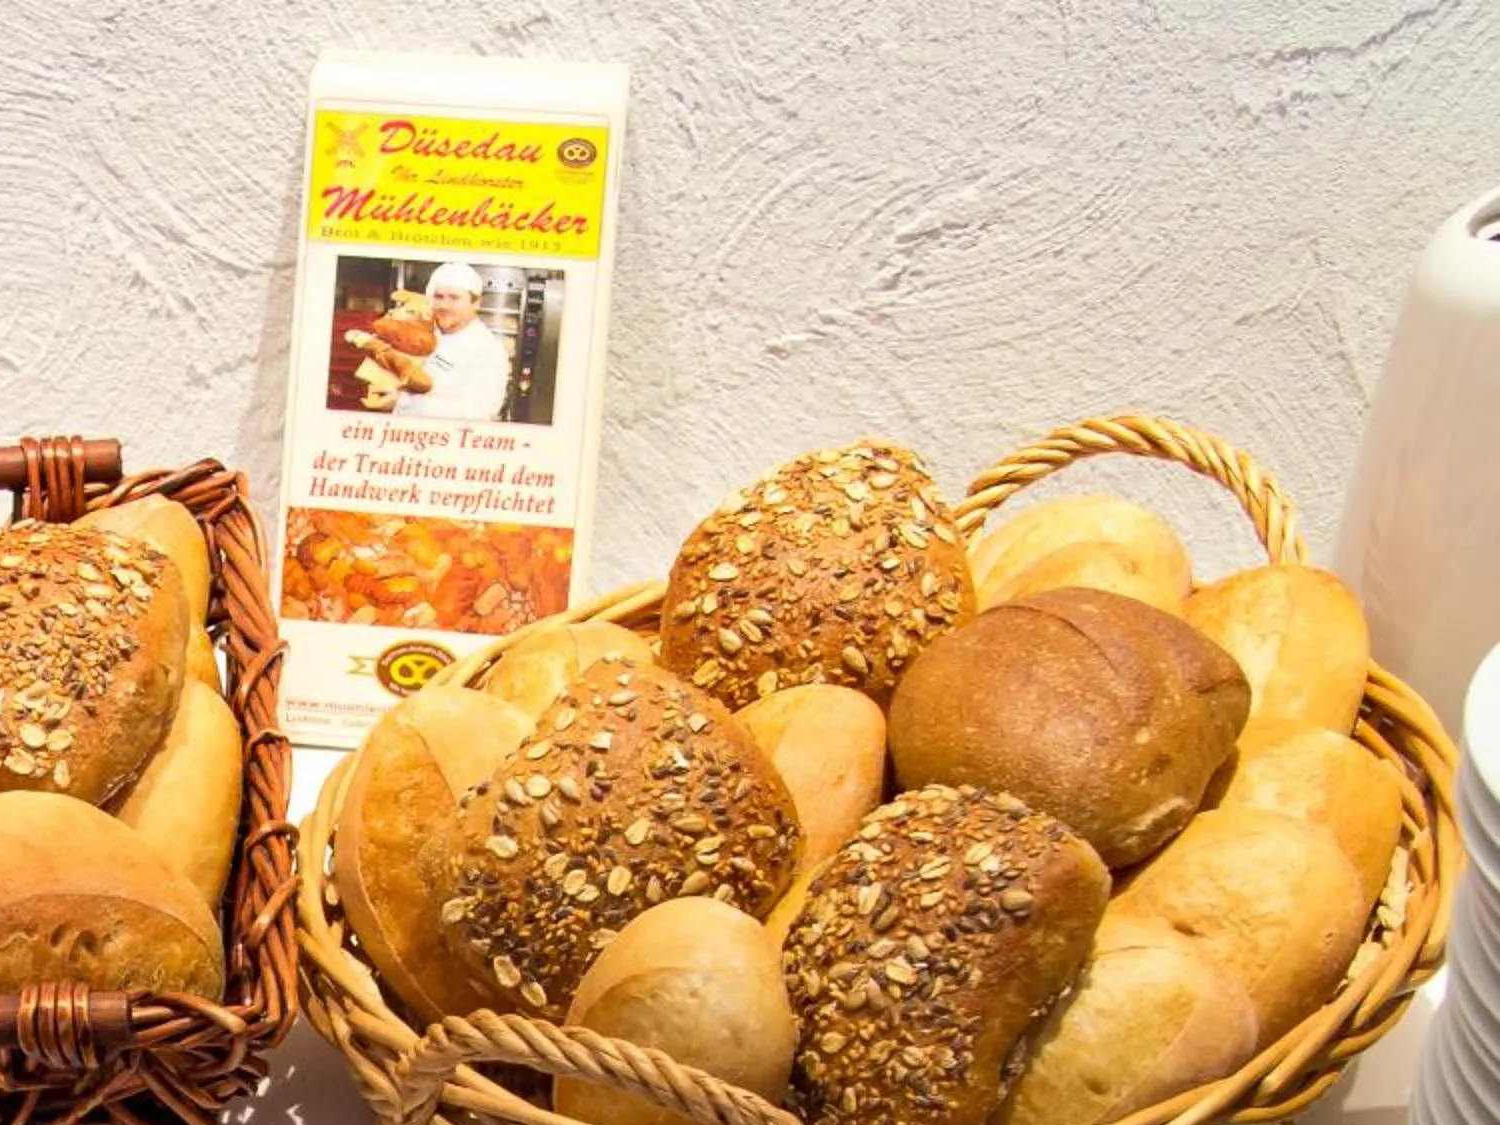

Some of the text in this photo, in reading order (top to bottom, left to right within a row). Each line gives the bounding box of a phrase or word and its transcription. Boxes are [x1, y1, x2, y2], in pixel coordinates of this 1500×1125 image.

[379, 120, 543, 164] Düsedau
[320, 185, 589, 236] Mühlenbäcker
[342, 419, 373, 442] ein
[380, 421, 450, 451] junges
[457, 427, 516, 452] Team
[312, 449, 555, 488] der Tradition und dem
[308, 476, 556, 515] Handwerk verpflichtet
